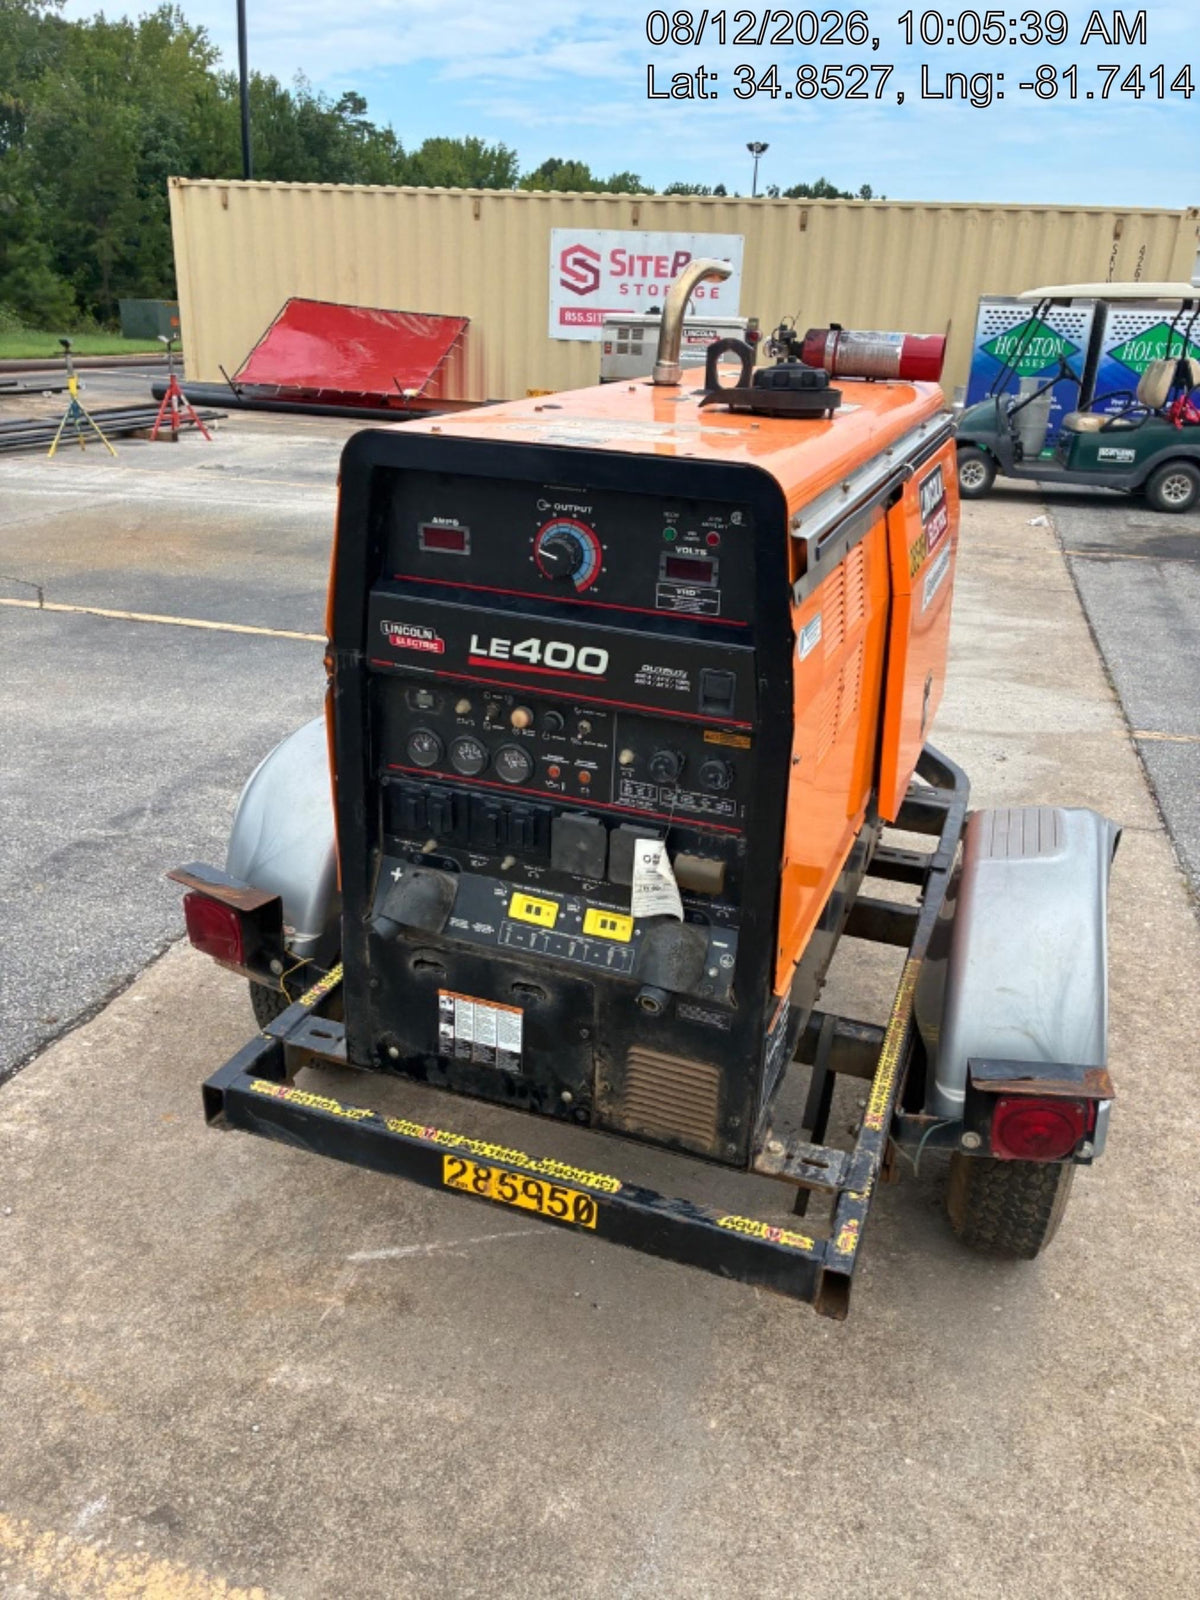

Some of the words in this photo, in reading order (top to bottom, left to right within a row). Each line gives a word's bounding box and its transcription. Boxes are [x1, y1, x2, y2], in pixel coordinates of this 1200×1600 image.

[564, 311, 602, 323] 855.SIT
[1121, 341, 1194, 361] HOLSON
[553, 503, 594, 513] OUTPUT
[431, 516, 460, 528] AMPS
[675, 545, 708, 556] VOLTS
[383, 622, 433, 640] LINCOLN
[395, 637, 439, 651] ELECTRIC
[469, 634, 610, 676] LE400
[488, 1146, 526, 1162] TENE
[446, 1157, 595, 1224] 285950
